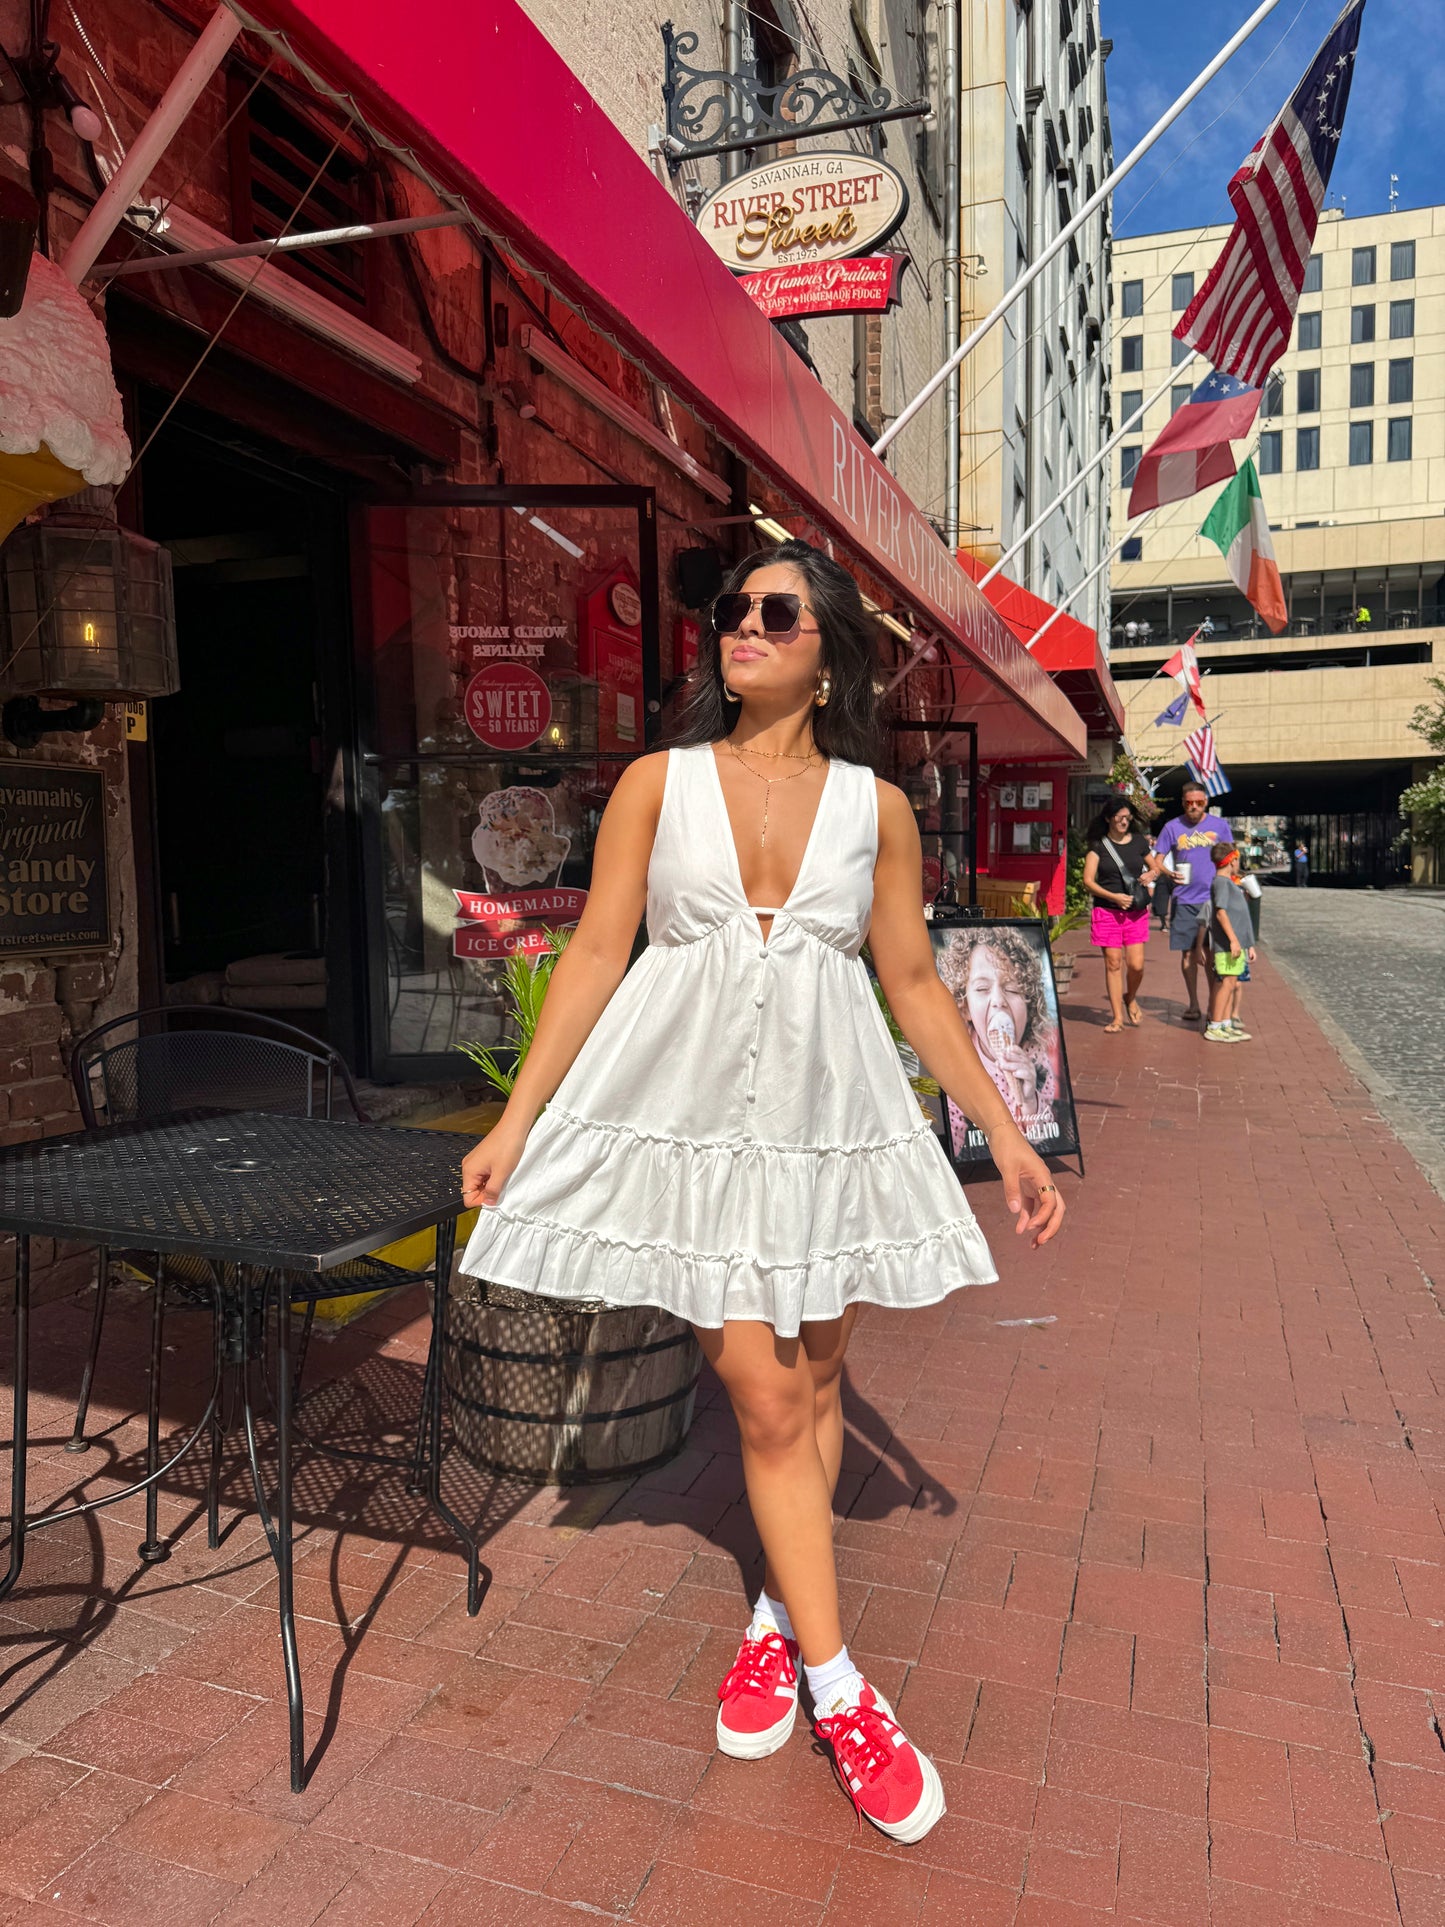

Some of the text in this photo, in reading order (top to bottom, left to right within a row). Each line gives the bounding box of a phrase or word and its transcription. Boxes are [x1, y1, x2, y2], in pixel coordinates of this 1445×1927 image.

[751, 161, 843, 190] SAVANNAH, GA
[713, 173, 883, 229] RIVER STREET
[736, 206, 858, 256] Sweets
[763, 272, 823, 299] Famous
[767, 296, 794, 310] TAFFY
[800, 291, 850, 304] HOMEMADE
[852, 287, 882, 300] FUDGE
[831, 415, 904, 570] RIVER
[907, 510, 962, 628] STREET
[964, 583, 1003, 670] SWEETS
[472, 690, 541, 718] SWEET
[488, 719, 501, 733] 50
[505, 719, 540, 733] YEARS!
[0, 787, 83, 808] avannah's
[469, 896, 578, 915] HOMEMADE
[0, 929, 100, 946] rstreetsweets.com
[467, 934, 551, 951] ICE CREA
[967, 1130, 986, 1147] ICE
[1026, 1121, 1060, 1140] GELATO
